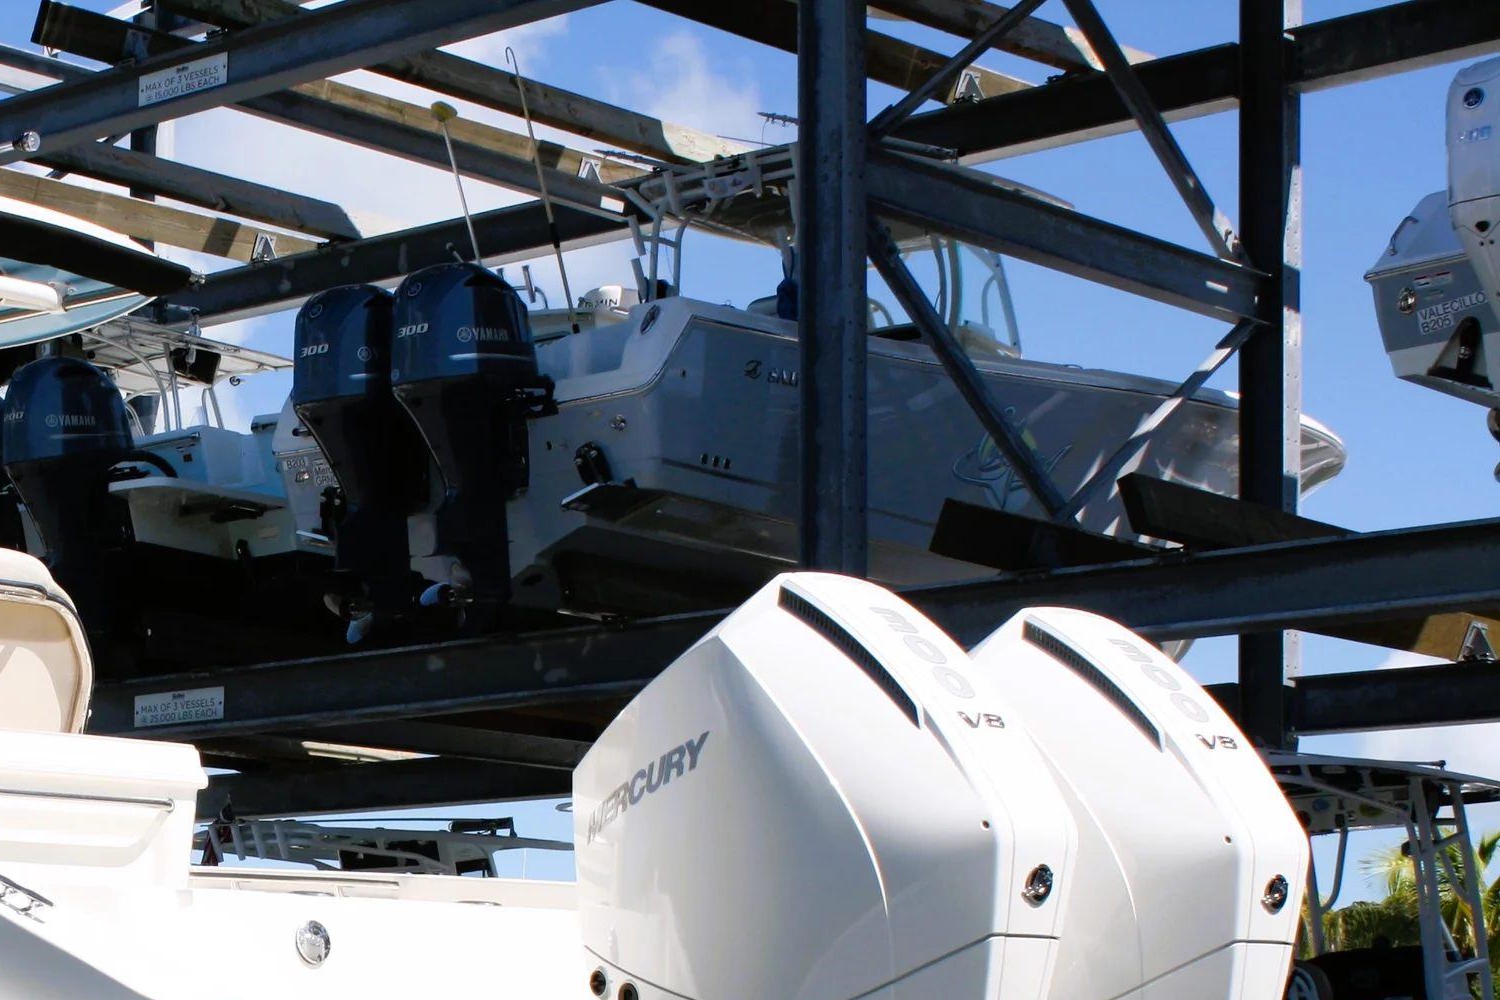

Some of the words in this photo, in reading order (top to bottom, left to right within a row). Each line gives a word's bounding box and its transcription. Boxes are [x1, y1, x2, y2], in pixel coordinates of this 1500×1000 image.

[145, 82, 162, 93] MAX
[164, 77, 175, 87] OF
[177, 74, 183, 84] 3
[185, 65, 219, 81] VESSELS
[180, 82, 196, 93] LBS
[197, 75, 220, 88] EACH
[1419, 291, 1486, 320] VALECILLO
[398, 322, 430, 338] 300
[1421, 315, 1452, 334] B205
[471, 327, 509, 342] YAMAHA
[300, 343, 330, 359] 300
[3, 410, 25, 423] 200
[57, 414, 97, 427] YAMAHA
[868, 606, 976, 699] 300
[1107, 638, 1210, 723] 300
[141, 704, 158, 714] MAX
[160, 702, 171, 712] OF
[173, 702, 178, 711] 3
[180, 697, 215, 710] VESSELS
[178, 710, 193, 720] LBS
[195, 707, 218, 719] EACH
[956, 711, 1006, 729] V8
[1194, 733, 1238, 750] V8
[587, 730, 710, 845] MERCURY
